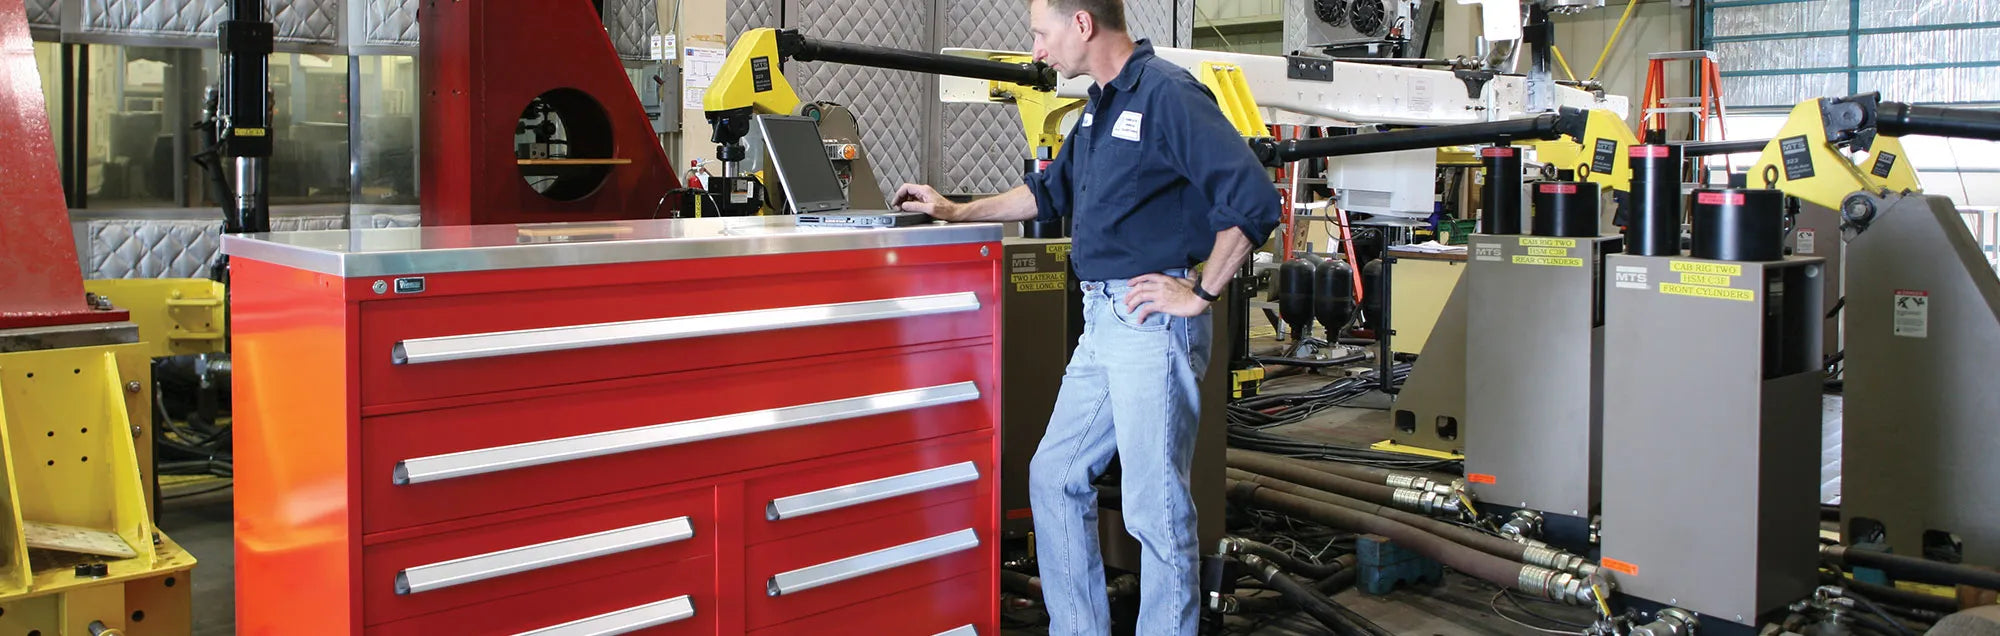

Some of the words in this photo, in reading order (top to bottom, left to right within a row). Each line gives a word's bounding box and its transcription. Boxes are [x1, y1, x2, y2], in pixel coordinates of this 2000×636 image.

[1537, 258, 1579, 266] CYLINDERS
[1674, 263, 1693, 271] CAB
[1695, 264, 1712, 273] RIG
[1715, 265, 1737, 274] TWO
[1013, 274, 1029, 282] TWO
[1030, 273, 1058, 281] LATERAL
[1663, 285, 1694, 295] FRONT
[1696, 287, 1749, 299] CYLINDERS
